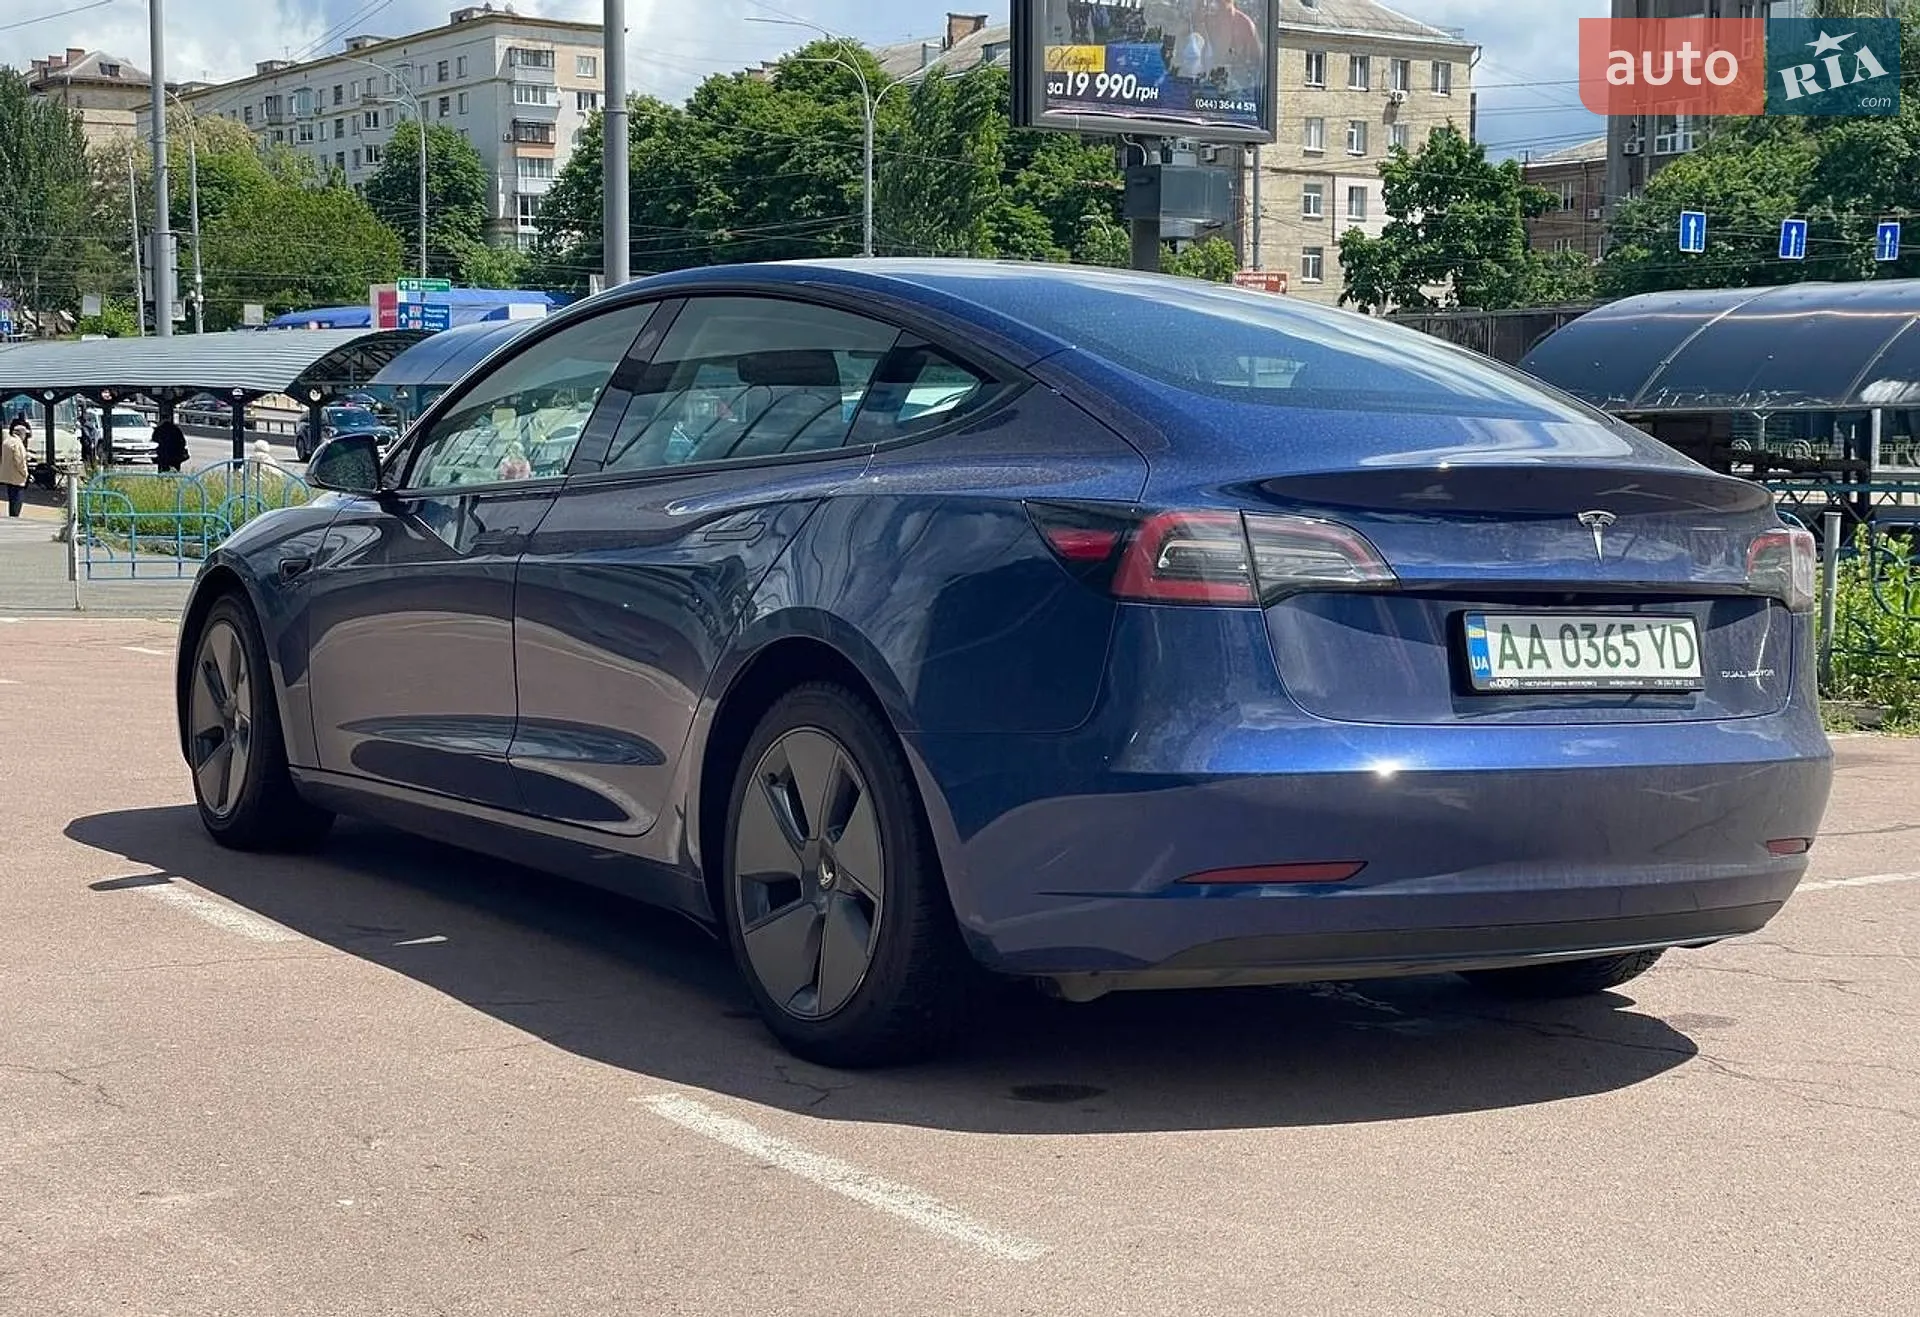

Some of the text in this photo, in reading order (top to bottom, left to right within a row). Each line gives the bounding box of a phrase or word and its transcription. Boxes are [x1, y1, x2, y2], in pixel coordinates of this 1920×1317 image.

[1047, 71, 1159, 101] за 19 990 грн
[1195, 98, 1217, 110] (044)
[1219, 99, 1235, 110] 364
[1498, 623, 1695, 670] AA 0365 YD
[1471, 655, 1489, 671] UA
[1721, 669, 1775, 678] DUAL MOTOR
